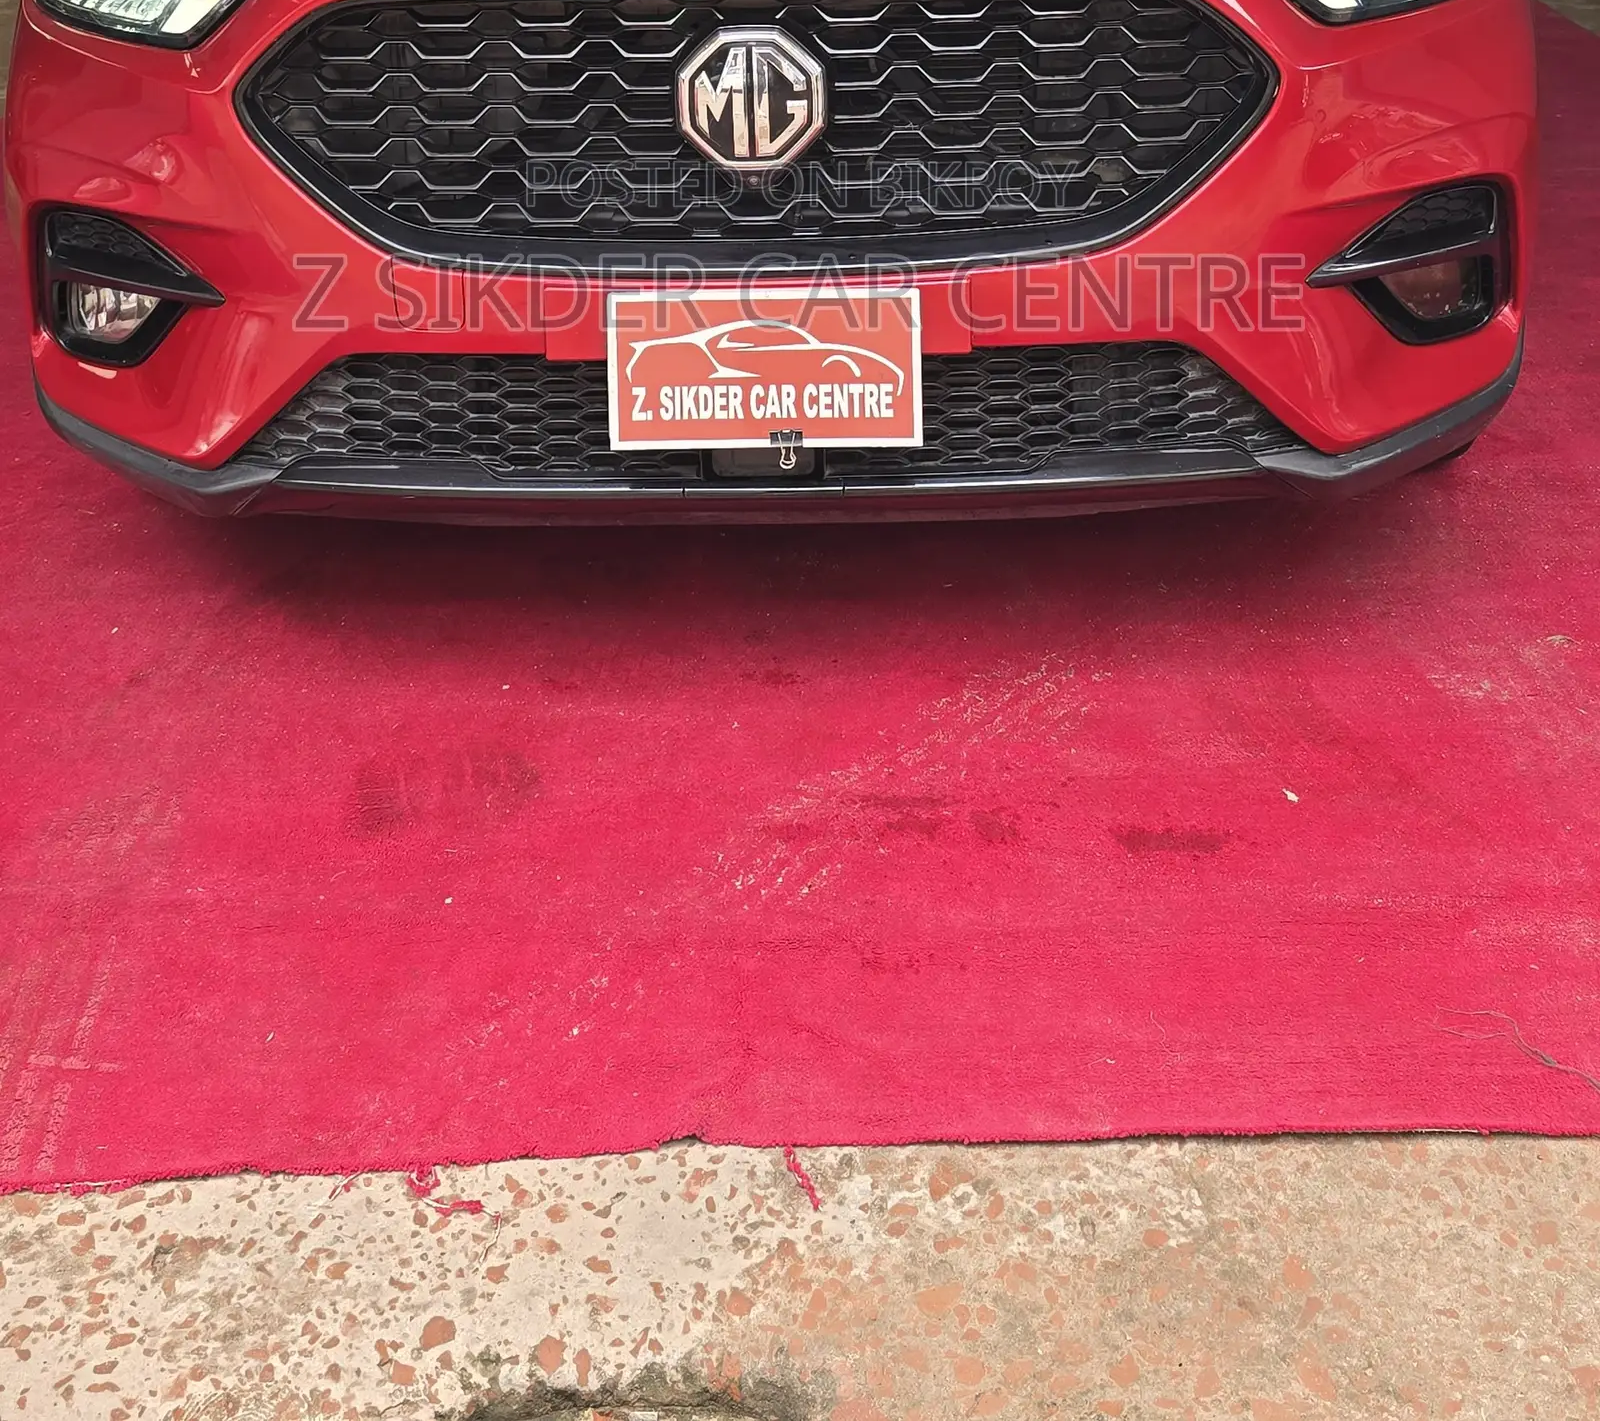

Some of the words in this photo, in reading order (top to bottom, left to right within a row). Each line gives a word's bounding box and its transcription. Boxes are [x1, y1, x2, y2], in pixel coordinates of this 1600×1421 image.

[694, 45, 808, 158] MG
[631, 385, 653, 421] Z.
[659, 383, 744, 421] SIKDER
[750, 383, 797, 419] CAR
[802, 382, 894, 419] CENTRE
